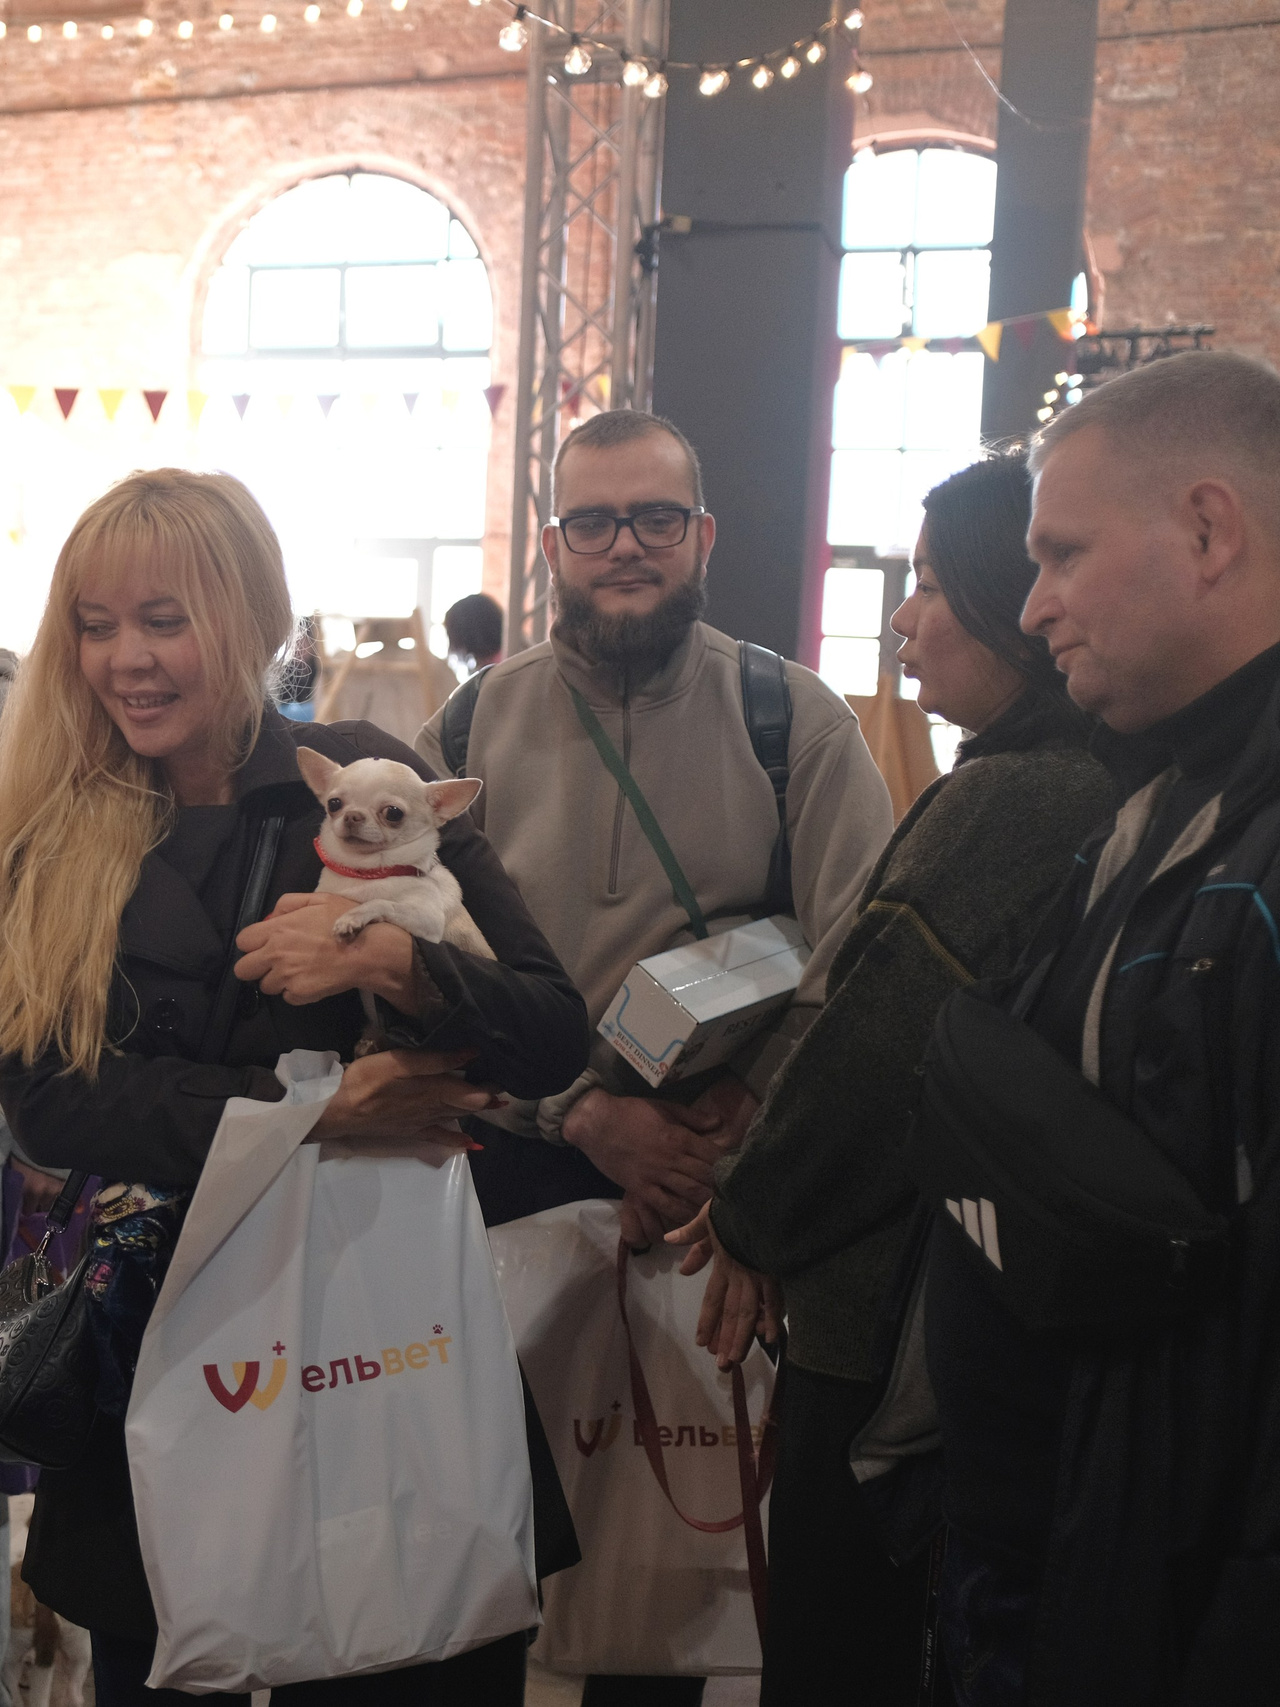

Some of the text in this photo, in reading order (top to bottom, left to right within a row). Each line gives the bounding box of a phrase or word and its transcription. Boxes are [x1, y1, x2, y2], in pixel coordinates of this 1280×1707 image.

[617, 1031, 661, 1078] BEST DINNER
[300, 1334, 453, 1394] ельвет
